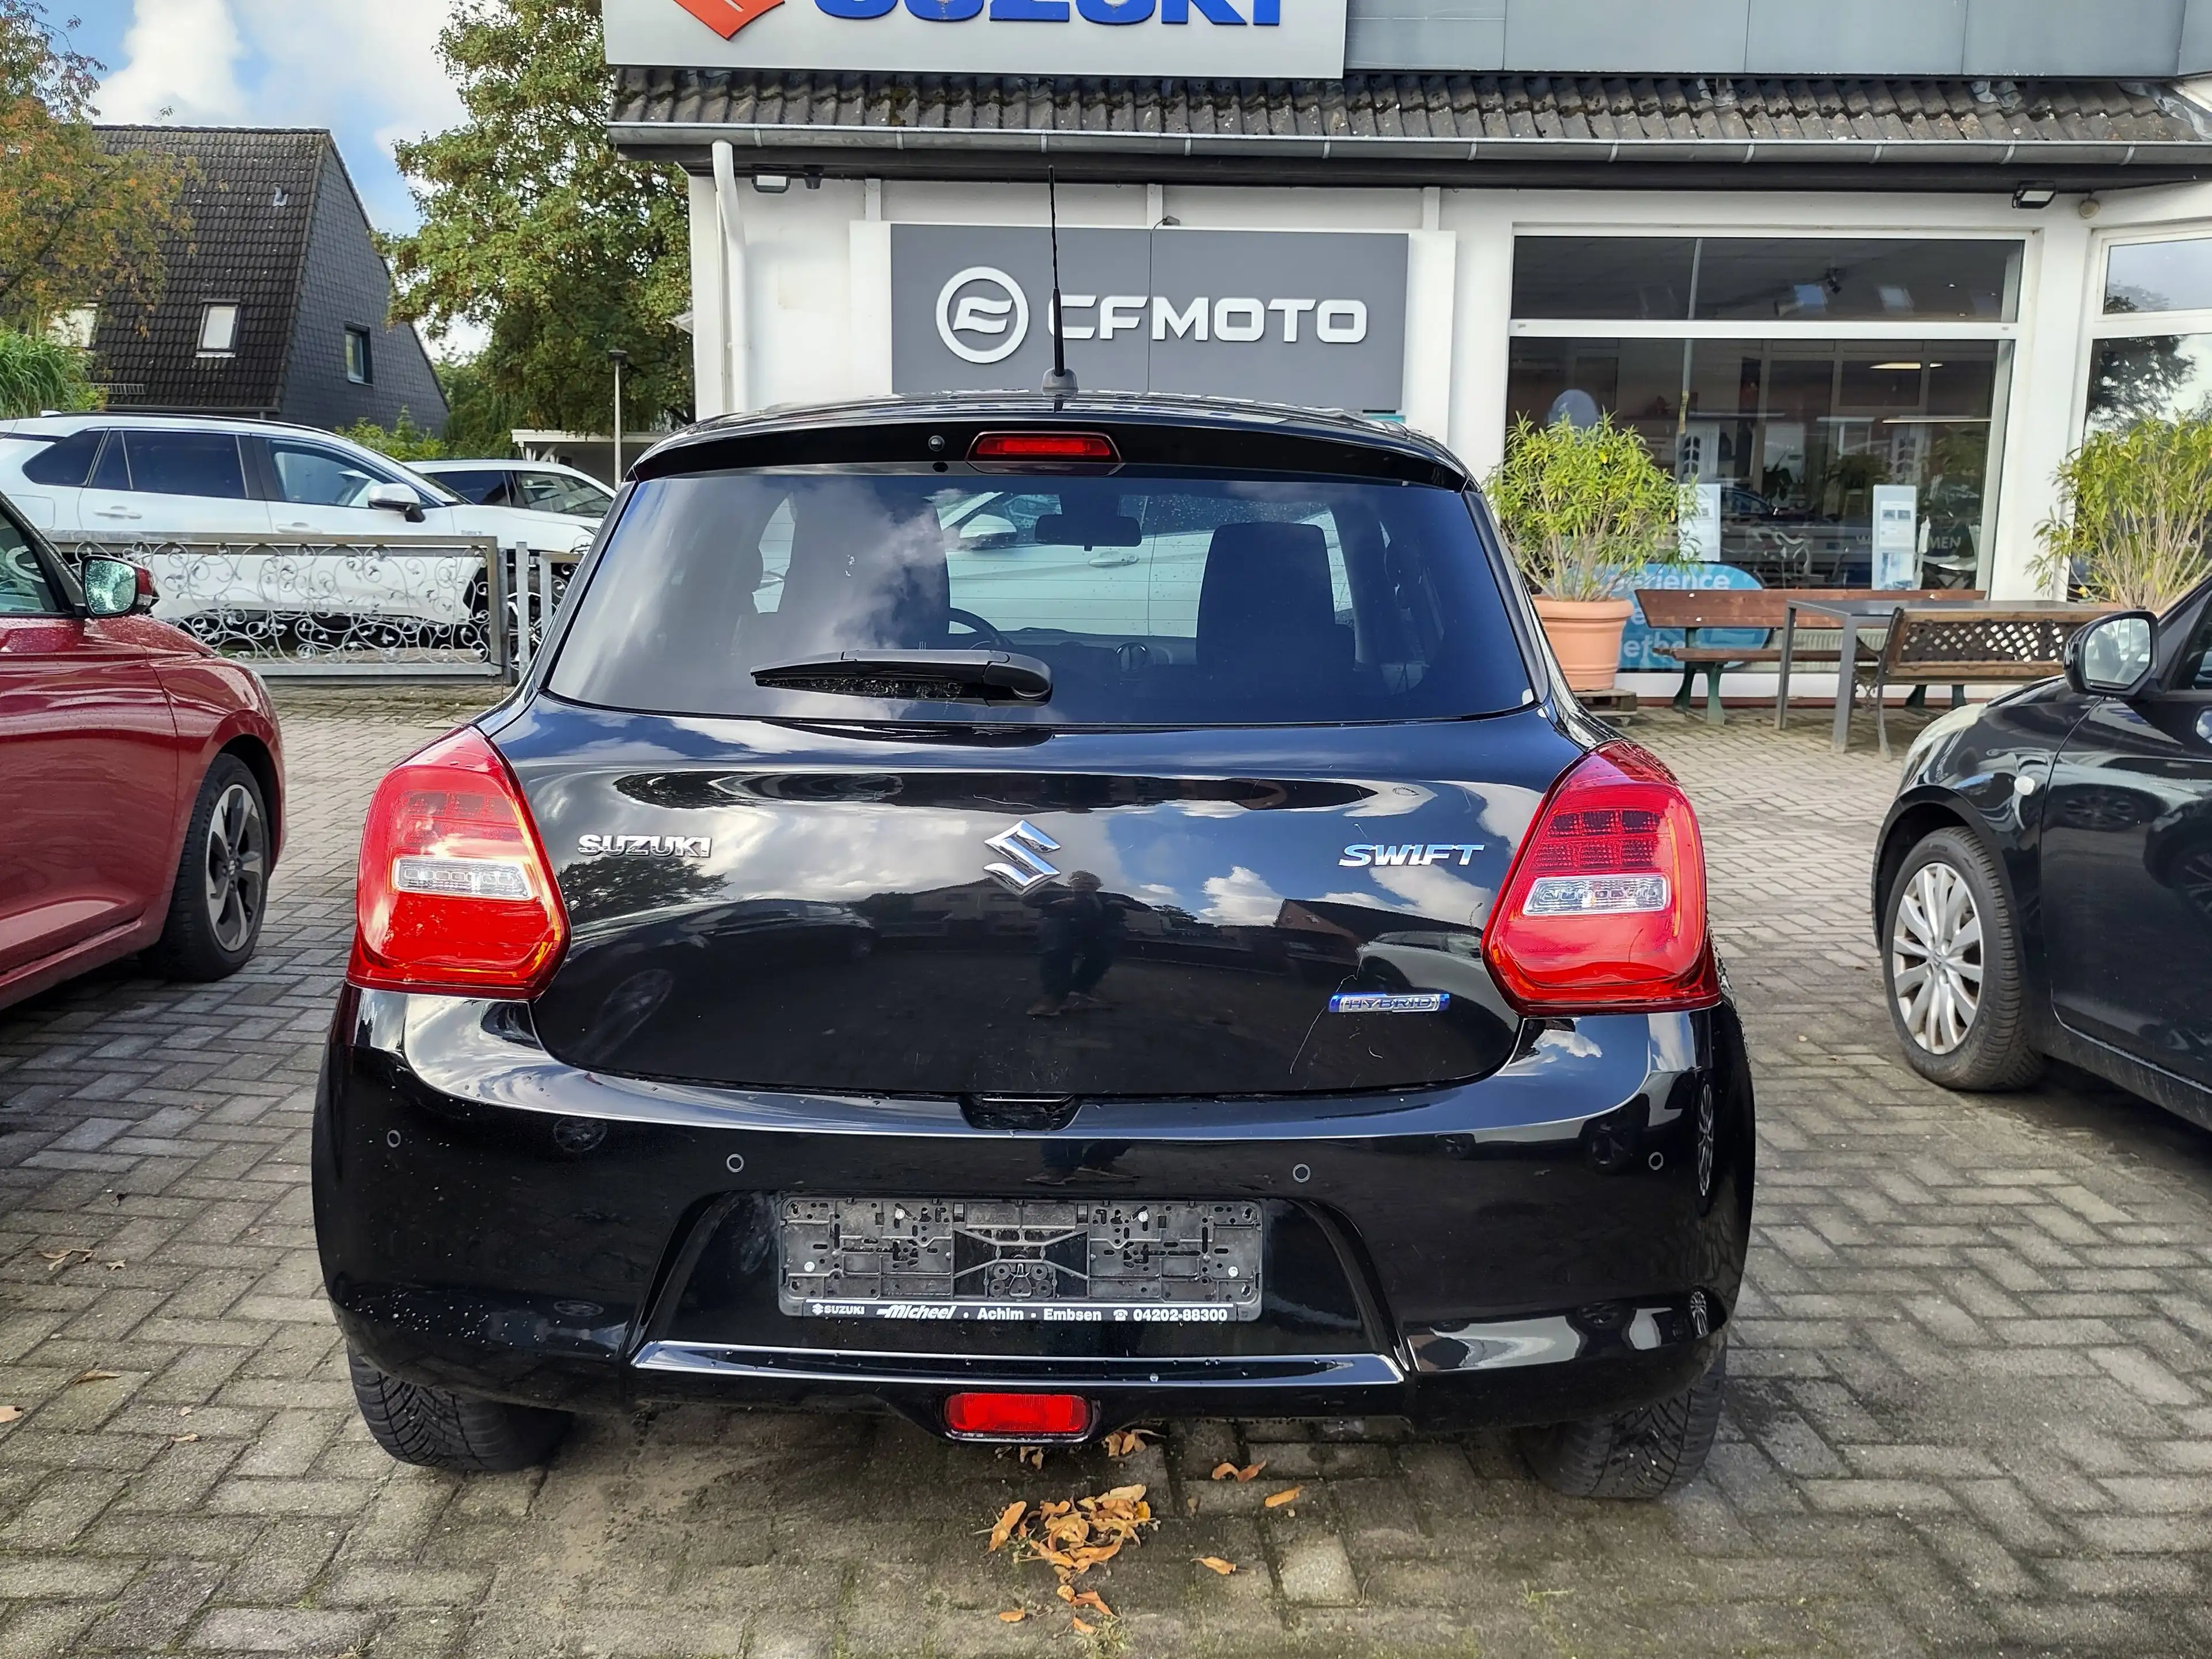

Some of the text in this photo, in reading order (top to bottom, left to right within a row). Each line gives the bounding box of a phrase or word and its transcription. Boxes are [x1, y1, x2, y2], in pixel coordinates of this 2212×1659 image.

[1048, 295, 1368, 343] CFMOTO
[577, 834, 712, 857] SUZUKI
[1338, 843, 1485, 867] SWIFT
[1344, 996, 1436, 1011] HYBRID
[824, 1305, 865, 1315] SUZUKI
[976, 1307, 1024, 1320] Achim
[1043, 1308, 1102, 1321] Embsen
[1132, 1308, 1228, 1321] 04202-88300
